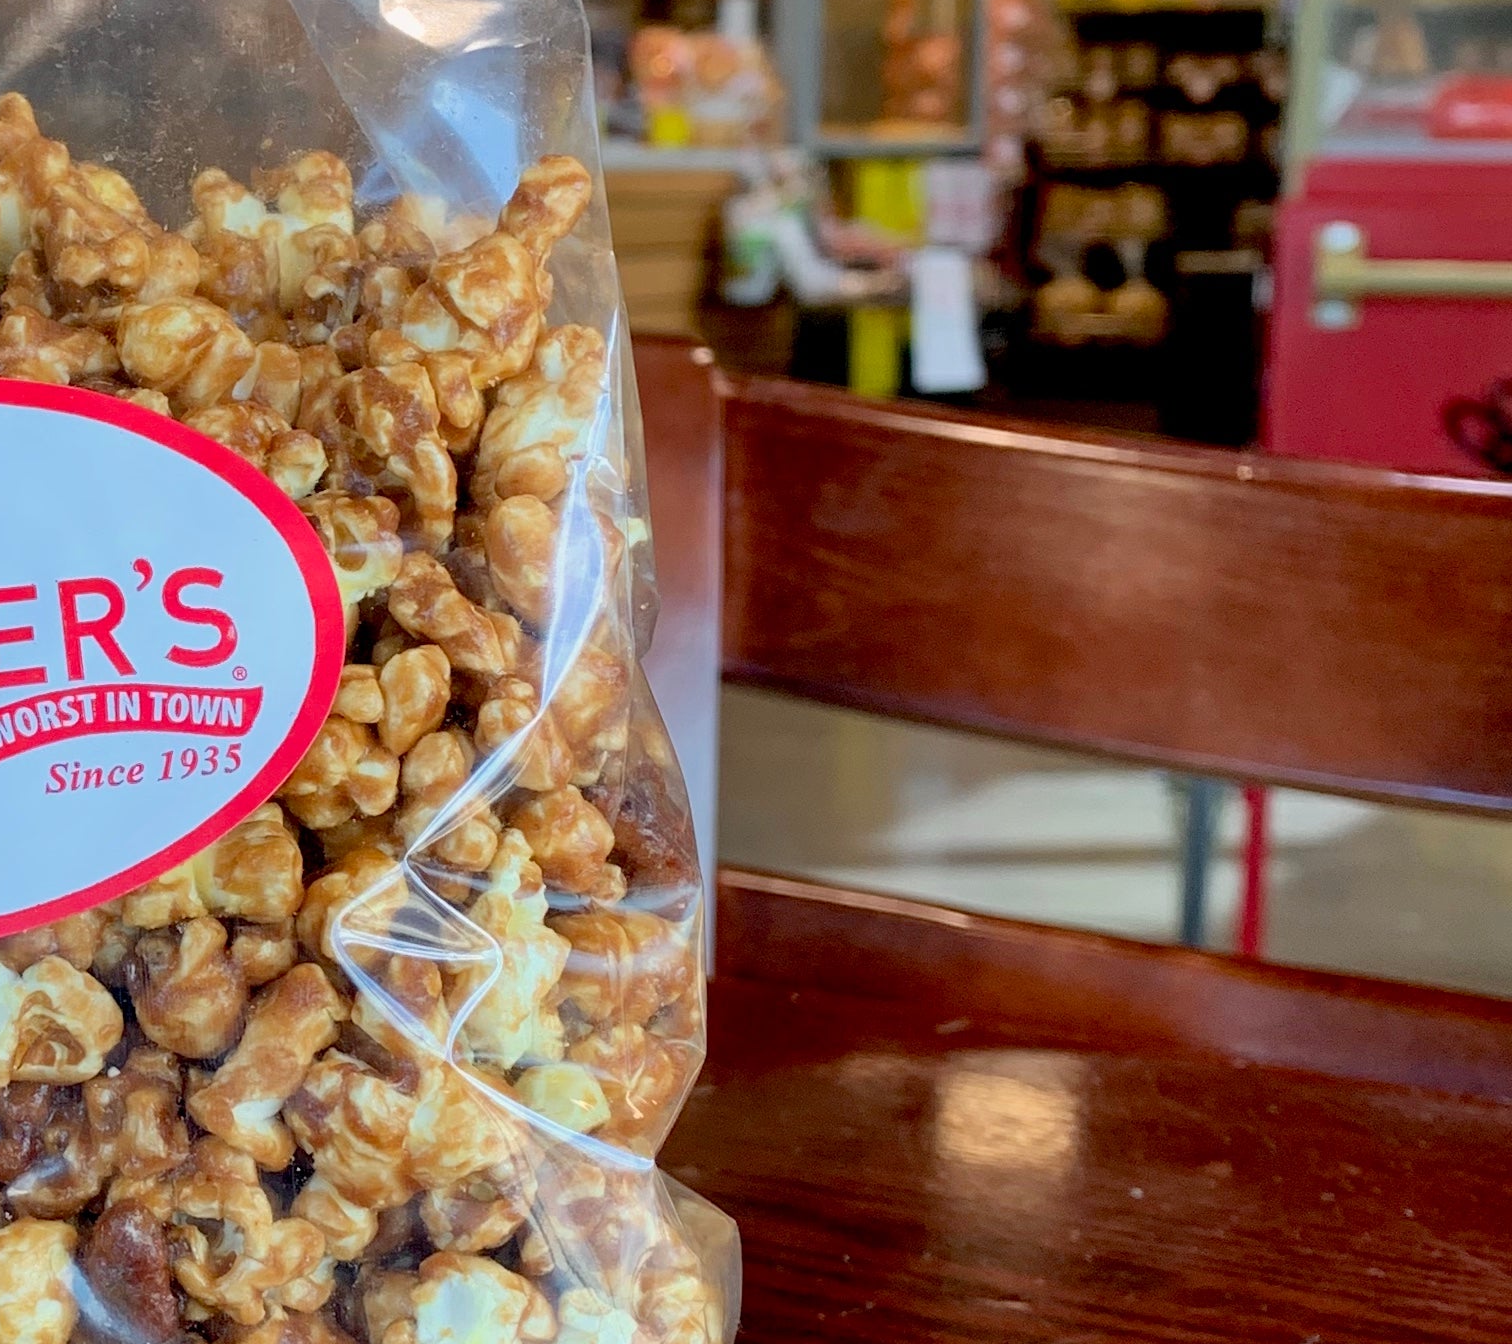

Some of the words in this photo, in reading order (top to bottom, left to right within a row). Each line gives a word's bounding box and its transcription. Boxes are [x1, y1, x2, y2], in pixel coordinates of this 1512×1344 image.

[106, 690, 140, 722] IN
[149, 691, 243, 727] TOWN
[45, 760, 144, 795] Since
[157, 742, 242, 782] 1935
